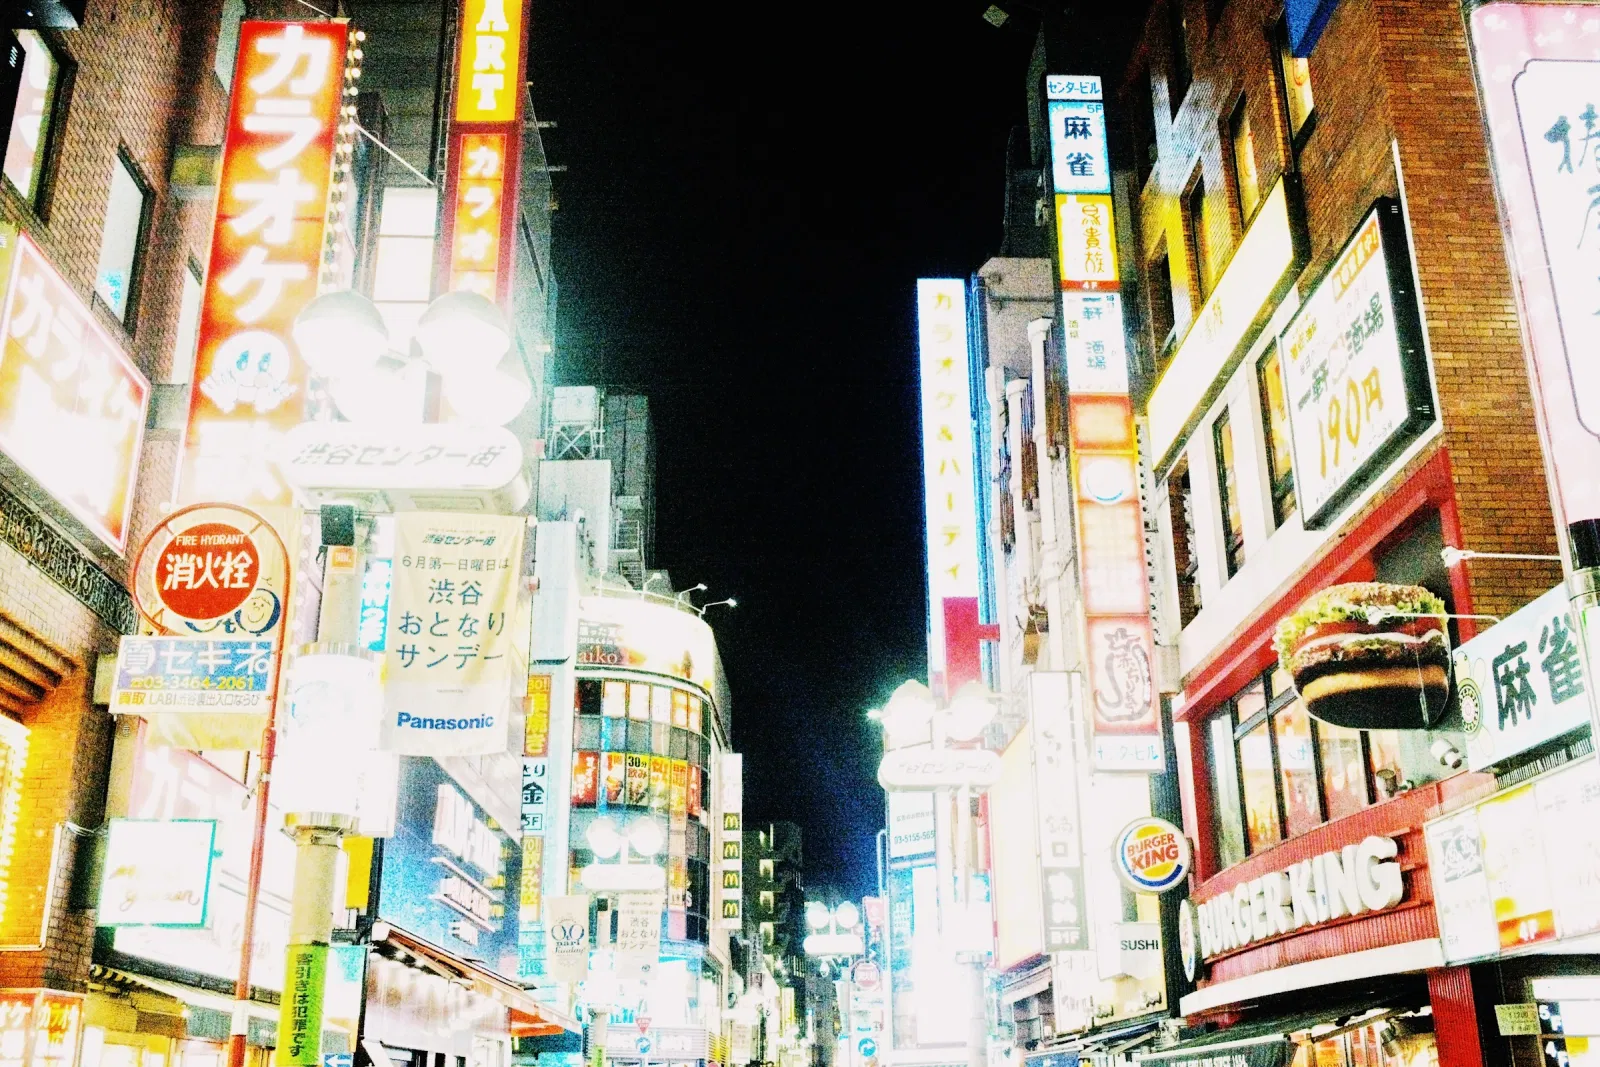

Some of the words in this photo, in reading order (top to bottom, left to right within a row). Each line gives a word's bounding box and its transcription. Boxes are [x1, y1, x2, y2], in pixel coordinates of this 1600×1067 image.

[1048, 80, 1101, 95] センタービル
[1063, 115, 1095, 177] 麻雀
[219, 25, 331, 324] カラオケ
[1317, 366, 1385, 481] 190円
[291, 442, 507, 469] 渋谷センター街
[176, 535, 197, 546] FIRE
[200, 533, 245, 545] HYDRANT
[163, 551, 253, 590] 消火栓
[402, 555, 510, 572] 6月第一日曜日は
[428, 578, 484, 606] 渋谷
[398, 611, 505, 638] おとなり
[396, 643, 504, 670] サンデー
[578, 645, 618, 665] aiko
[1492, 612, 1586, 732] 麻雀
[396, 711, 495, 730] Panasonic
[1126, 832, 1176, 857] BURGER
[1130, 843, 1180, 872] KING
[1197, 870, 1290, 958] BURGER
[1286, 835, 1403, 927] KING
[1120, 939, 1159, 951] SUSHI
